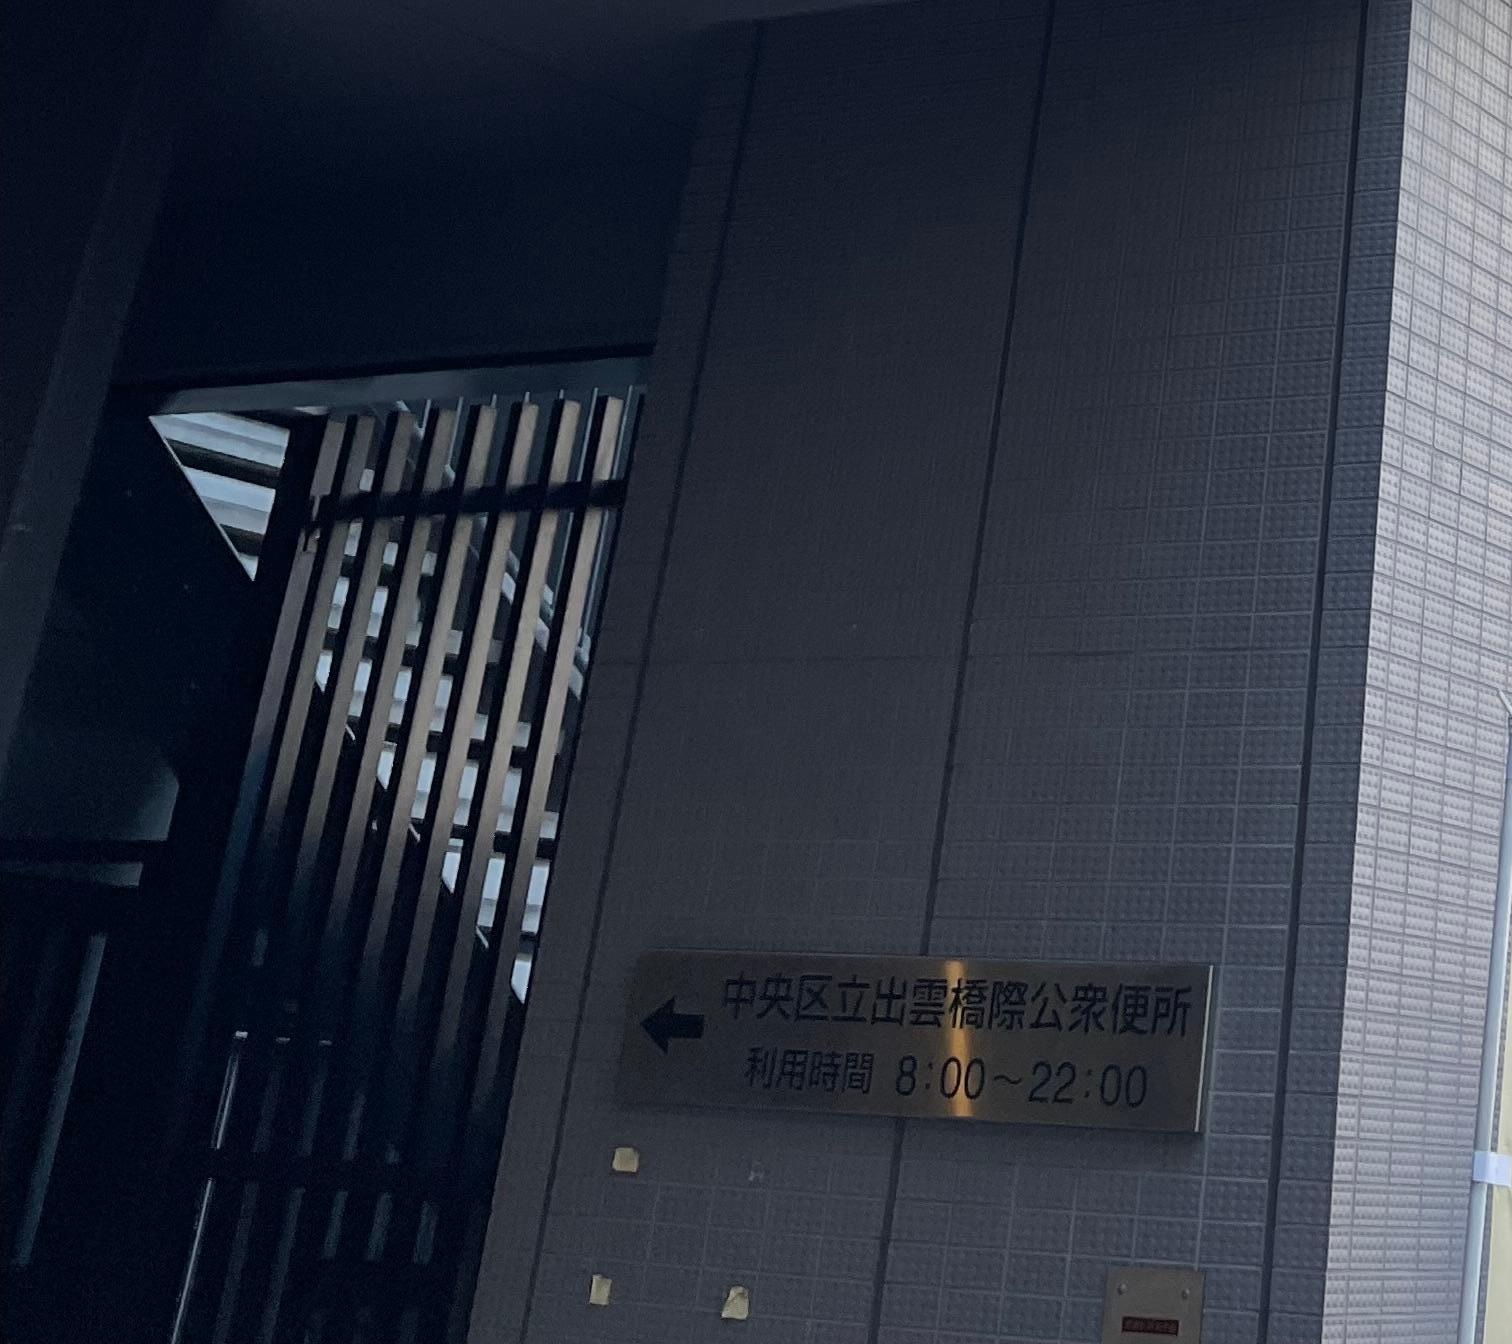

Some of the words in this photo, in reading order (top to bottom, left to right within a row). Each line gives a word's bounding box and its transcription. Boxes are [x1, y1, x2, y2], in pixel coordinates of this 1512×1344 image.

[721, 970, 1193, 1038] 中央区立出雲橋際公衆便所
[745, 1047, 875, 1096] 利用時間
